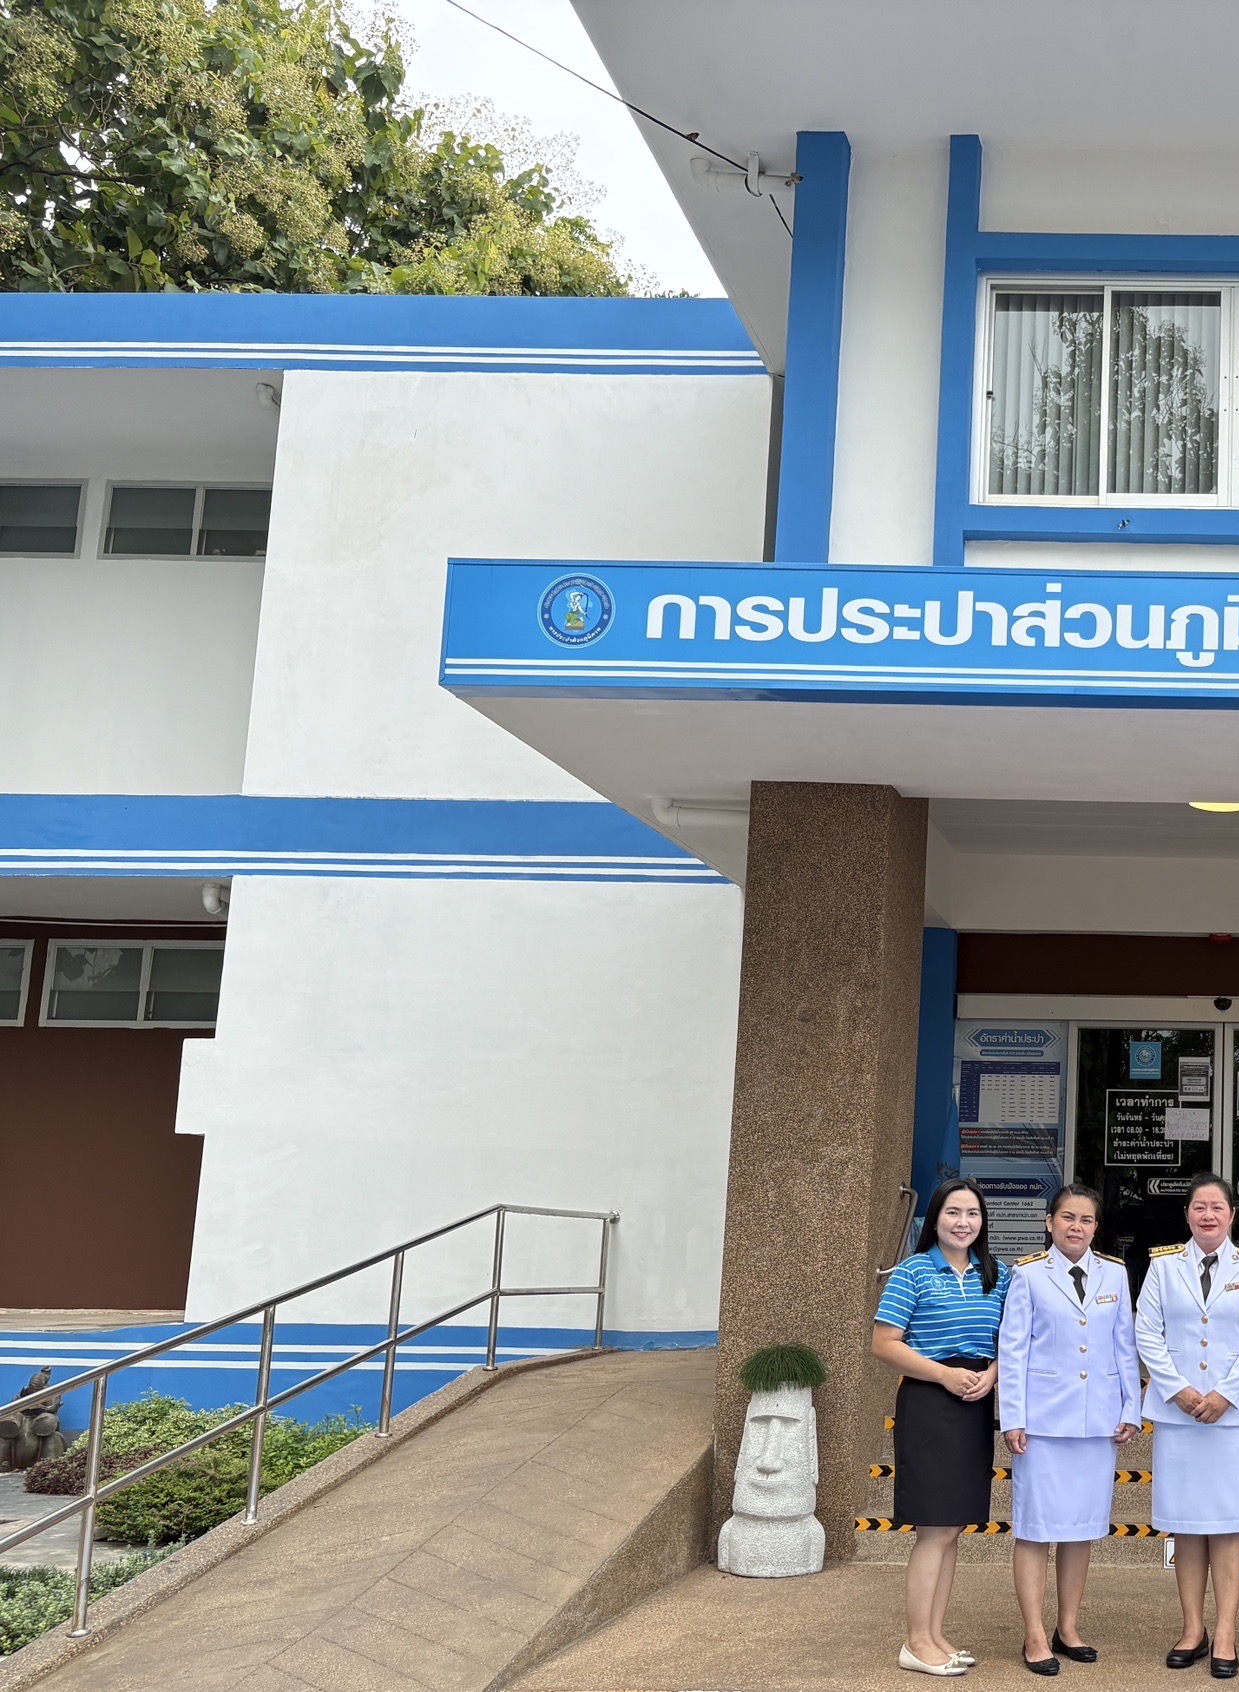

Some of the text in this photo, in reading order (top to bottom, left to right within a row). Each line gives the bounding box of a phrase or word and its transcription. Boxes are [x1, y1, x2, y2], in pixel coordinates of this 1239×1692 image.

[979, 1030, 1045, 1044] อัตราค่าน้ำประปา
[1115, 1095, 1174, 1107] เวลาทำการ
[1116, 1112, 1143, 1121] วันจันทร์
[1113, 1136, 1174, 1147] ชำระค่าน้ำประปา
[1114, 1149, 1174, 1163] (ไม่หยุดพักเที่ยง)
